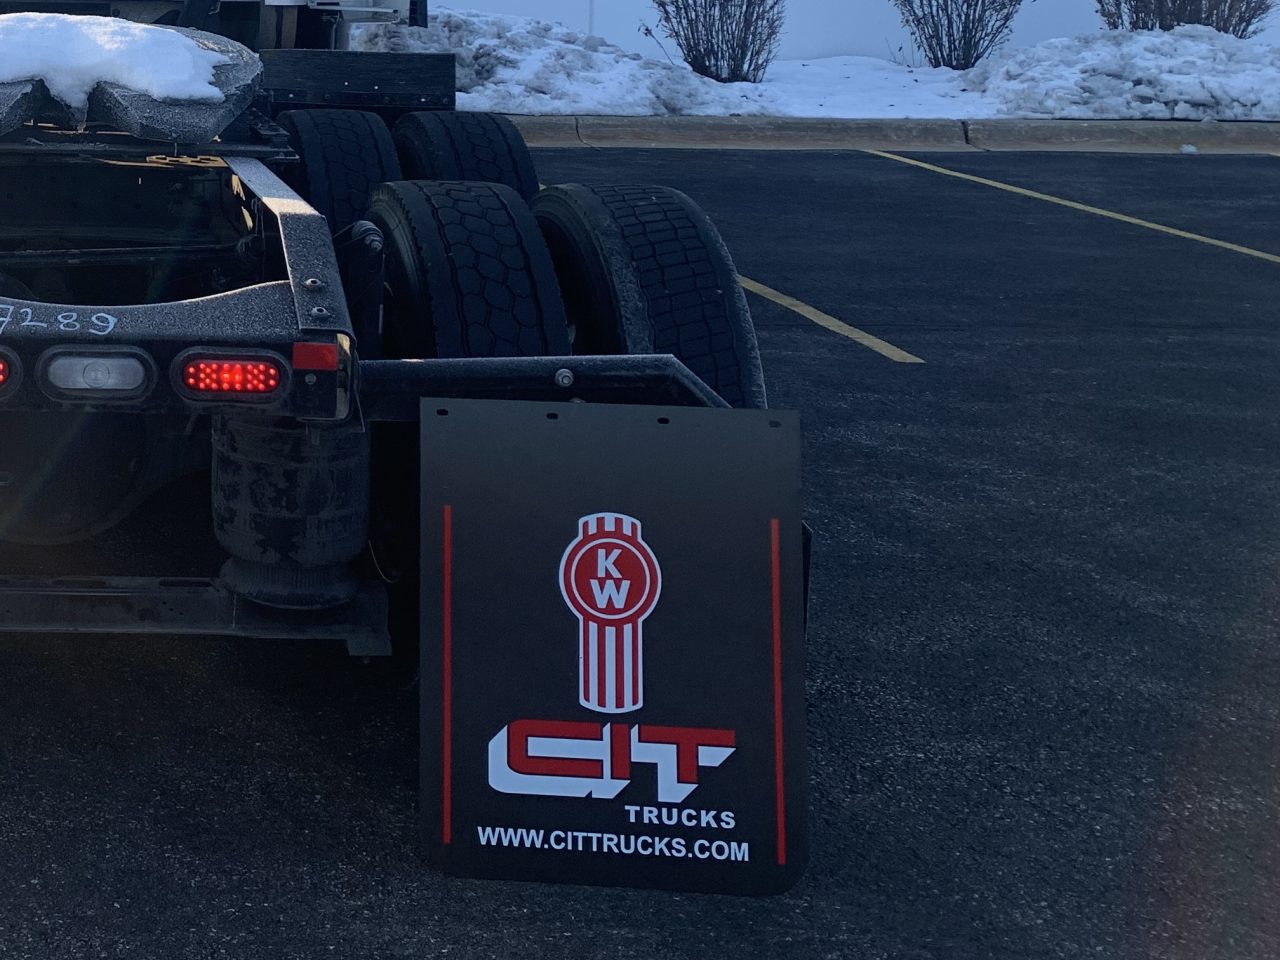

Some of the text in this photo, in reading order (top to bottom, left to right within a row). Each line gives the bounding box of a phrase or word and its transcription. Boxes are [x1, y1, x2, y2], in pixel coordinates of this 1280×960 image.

[488, 719, 736, 803] CIT
[624, 805, 737, 829] TRUCKS
[477, 826, 750, 862] WWW.CITTRUCKS.COM
